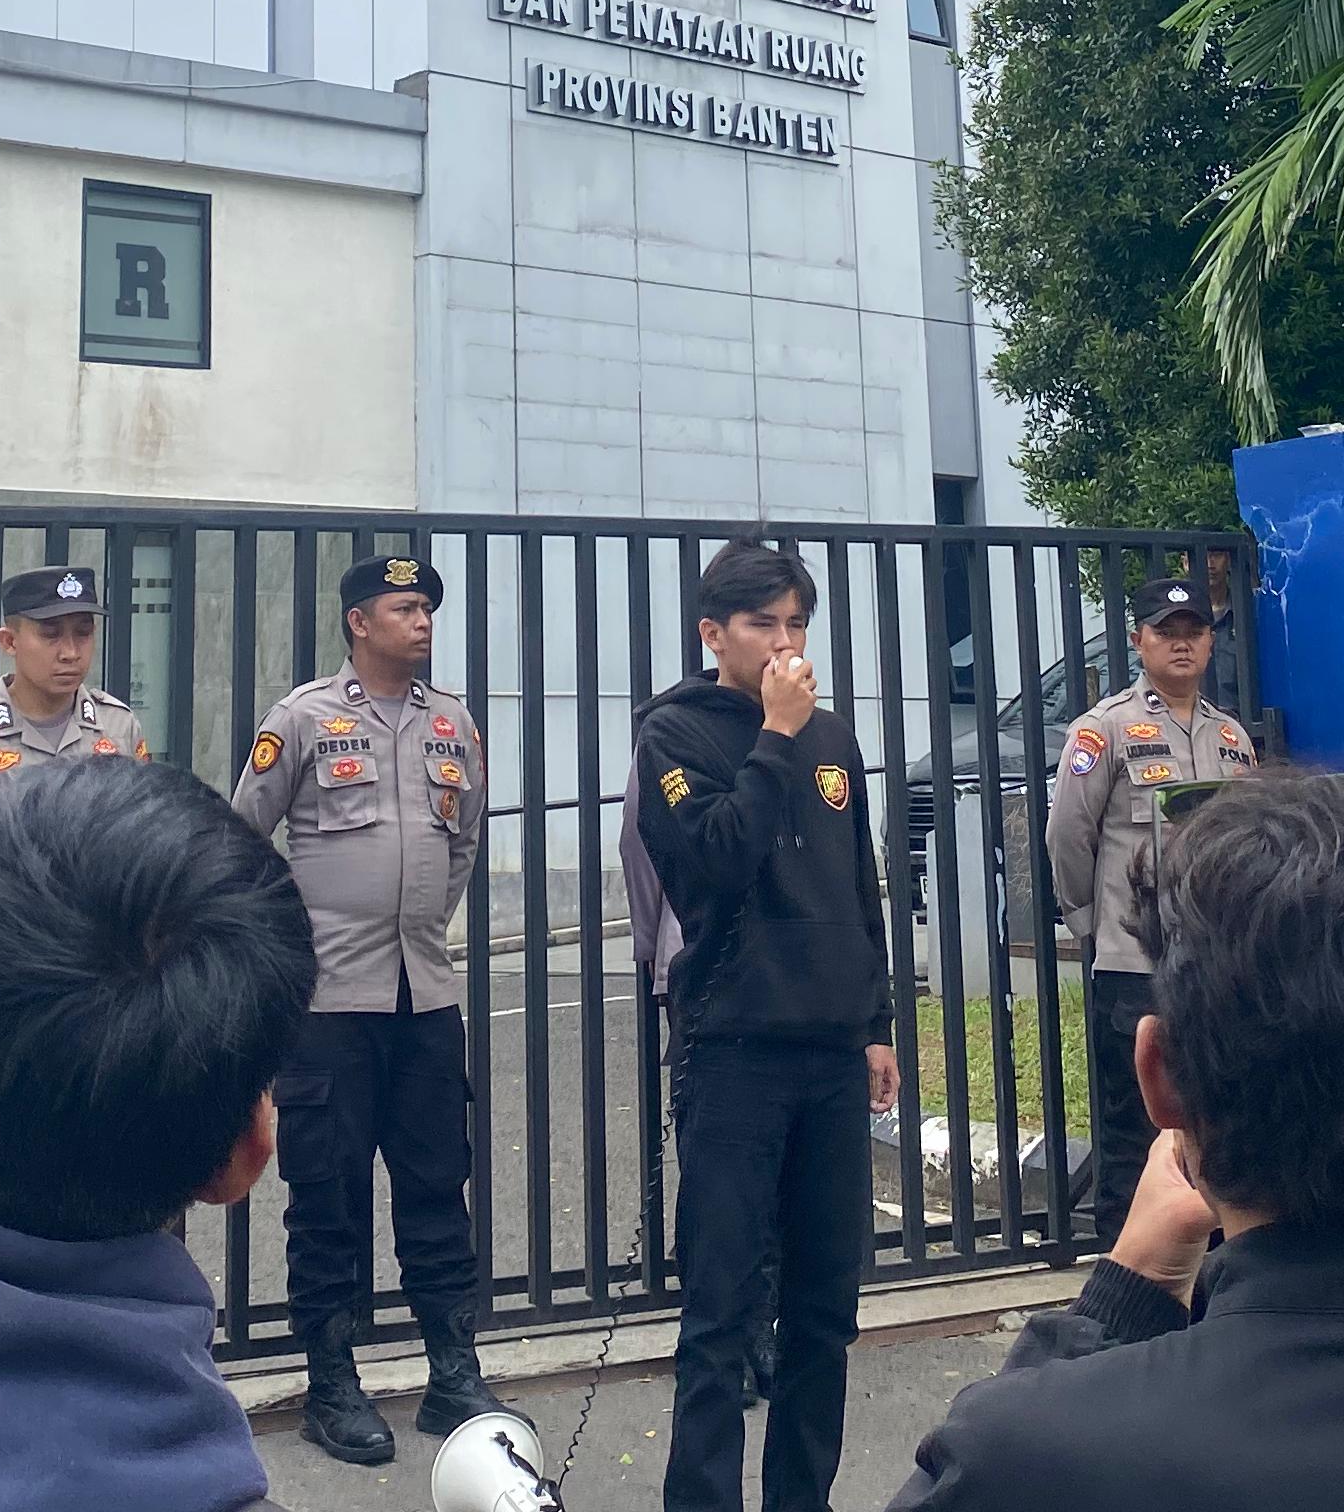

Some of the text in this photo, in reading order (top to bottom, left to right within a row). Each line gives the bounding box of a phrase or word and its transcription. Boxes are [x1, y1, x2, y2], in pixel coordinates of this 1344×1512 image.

[766, 30, 868, 86] RUANG
[537, 63, 839, 156] PROVINSI BANTEN
[114, 242, 170, 320] R
[318, 738, 371, 755] DEDEN
[424, 742, 466, 759] POLRI
